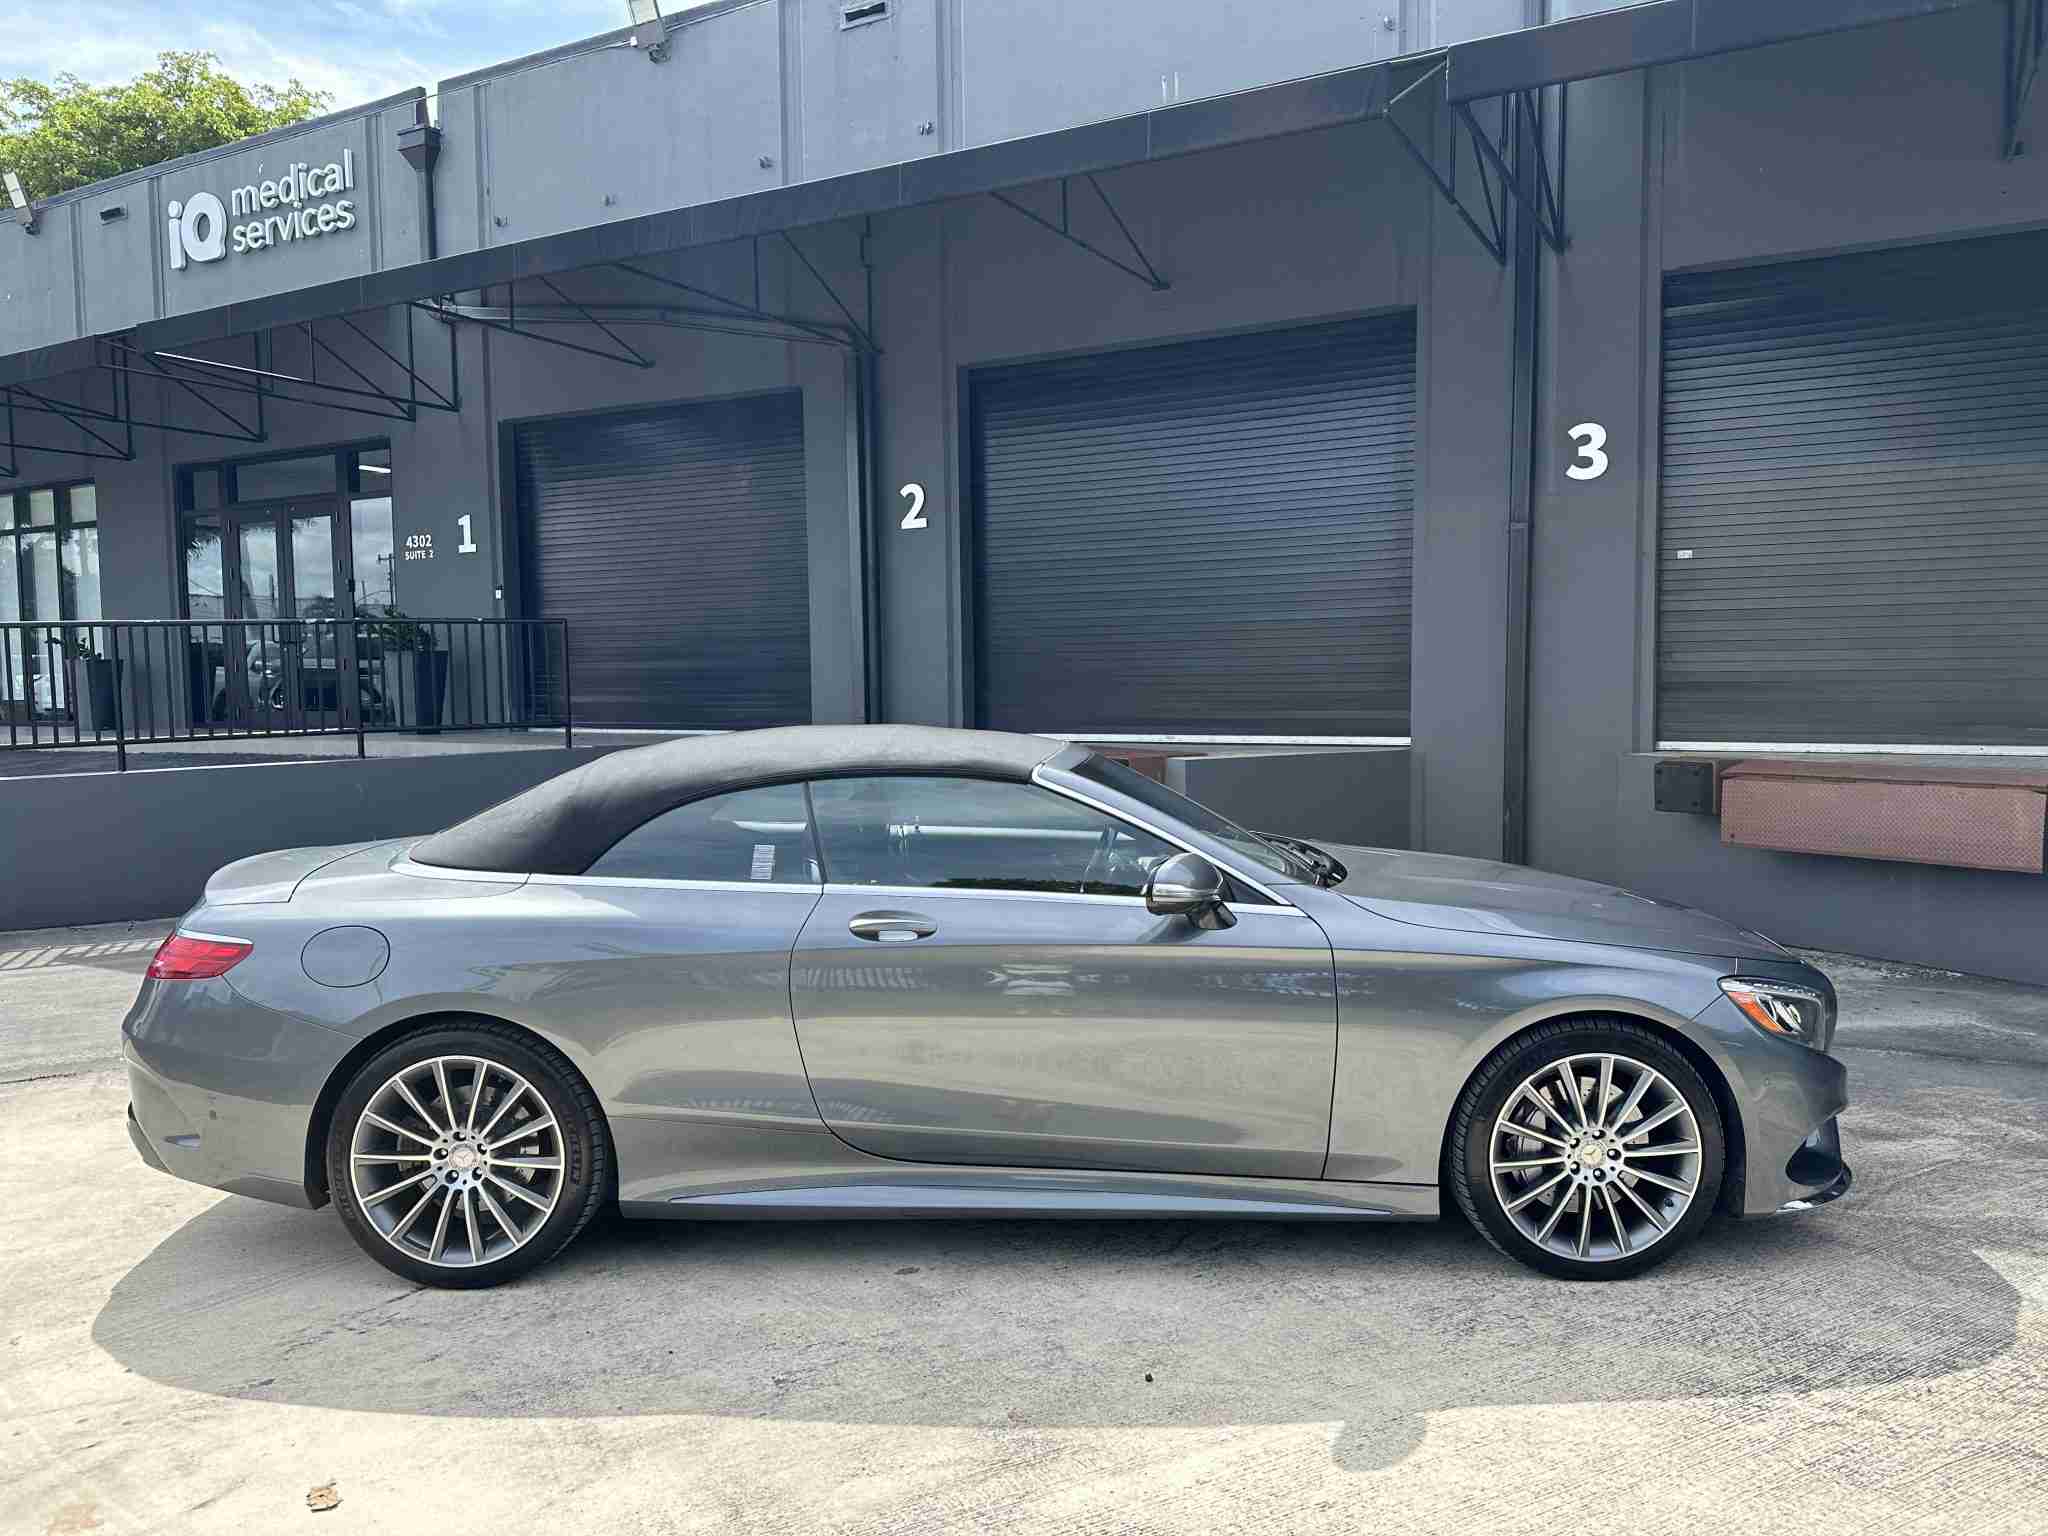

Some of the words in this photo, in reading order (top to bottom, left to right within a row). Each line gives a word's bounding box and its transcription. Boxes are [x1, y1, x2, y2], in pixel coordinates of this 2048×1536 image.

[231, 148, 354, 217] medical
[232, 199, 356, 253] services
[1565, 422, 1609, 480] 3
[899, 483, 928, 529] 2
[404, 550, 427, 561] SUITE
[405, 534, 432, 549] 4302
[457, 513, 477, 553] 1
